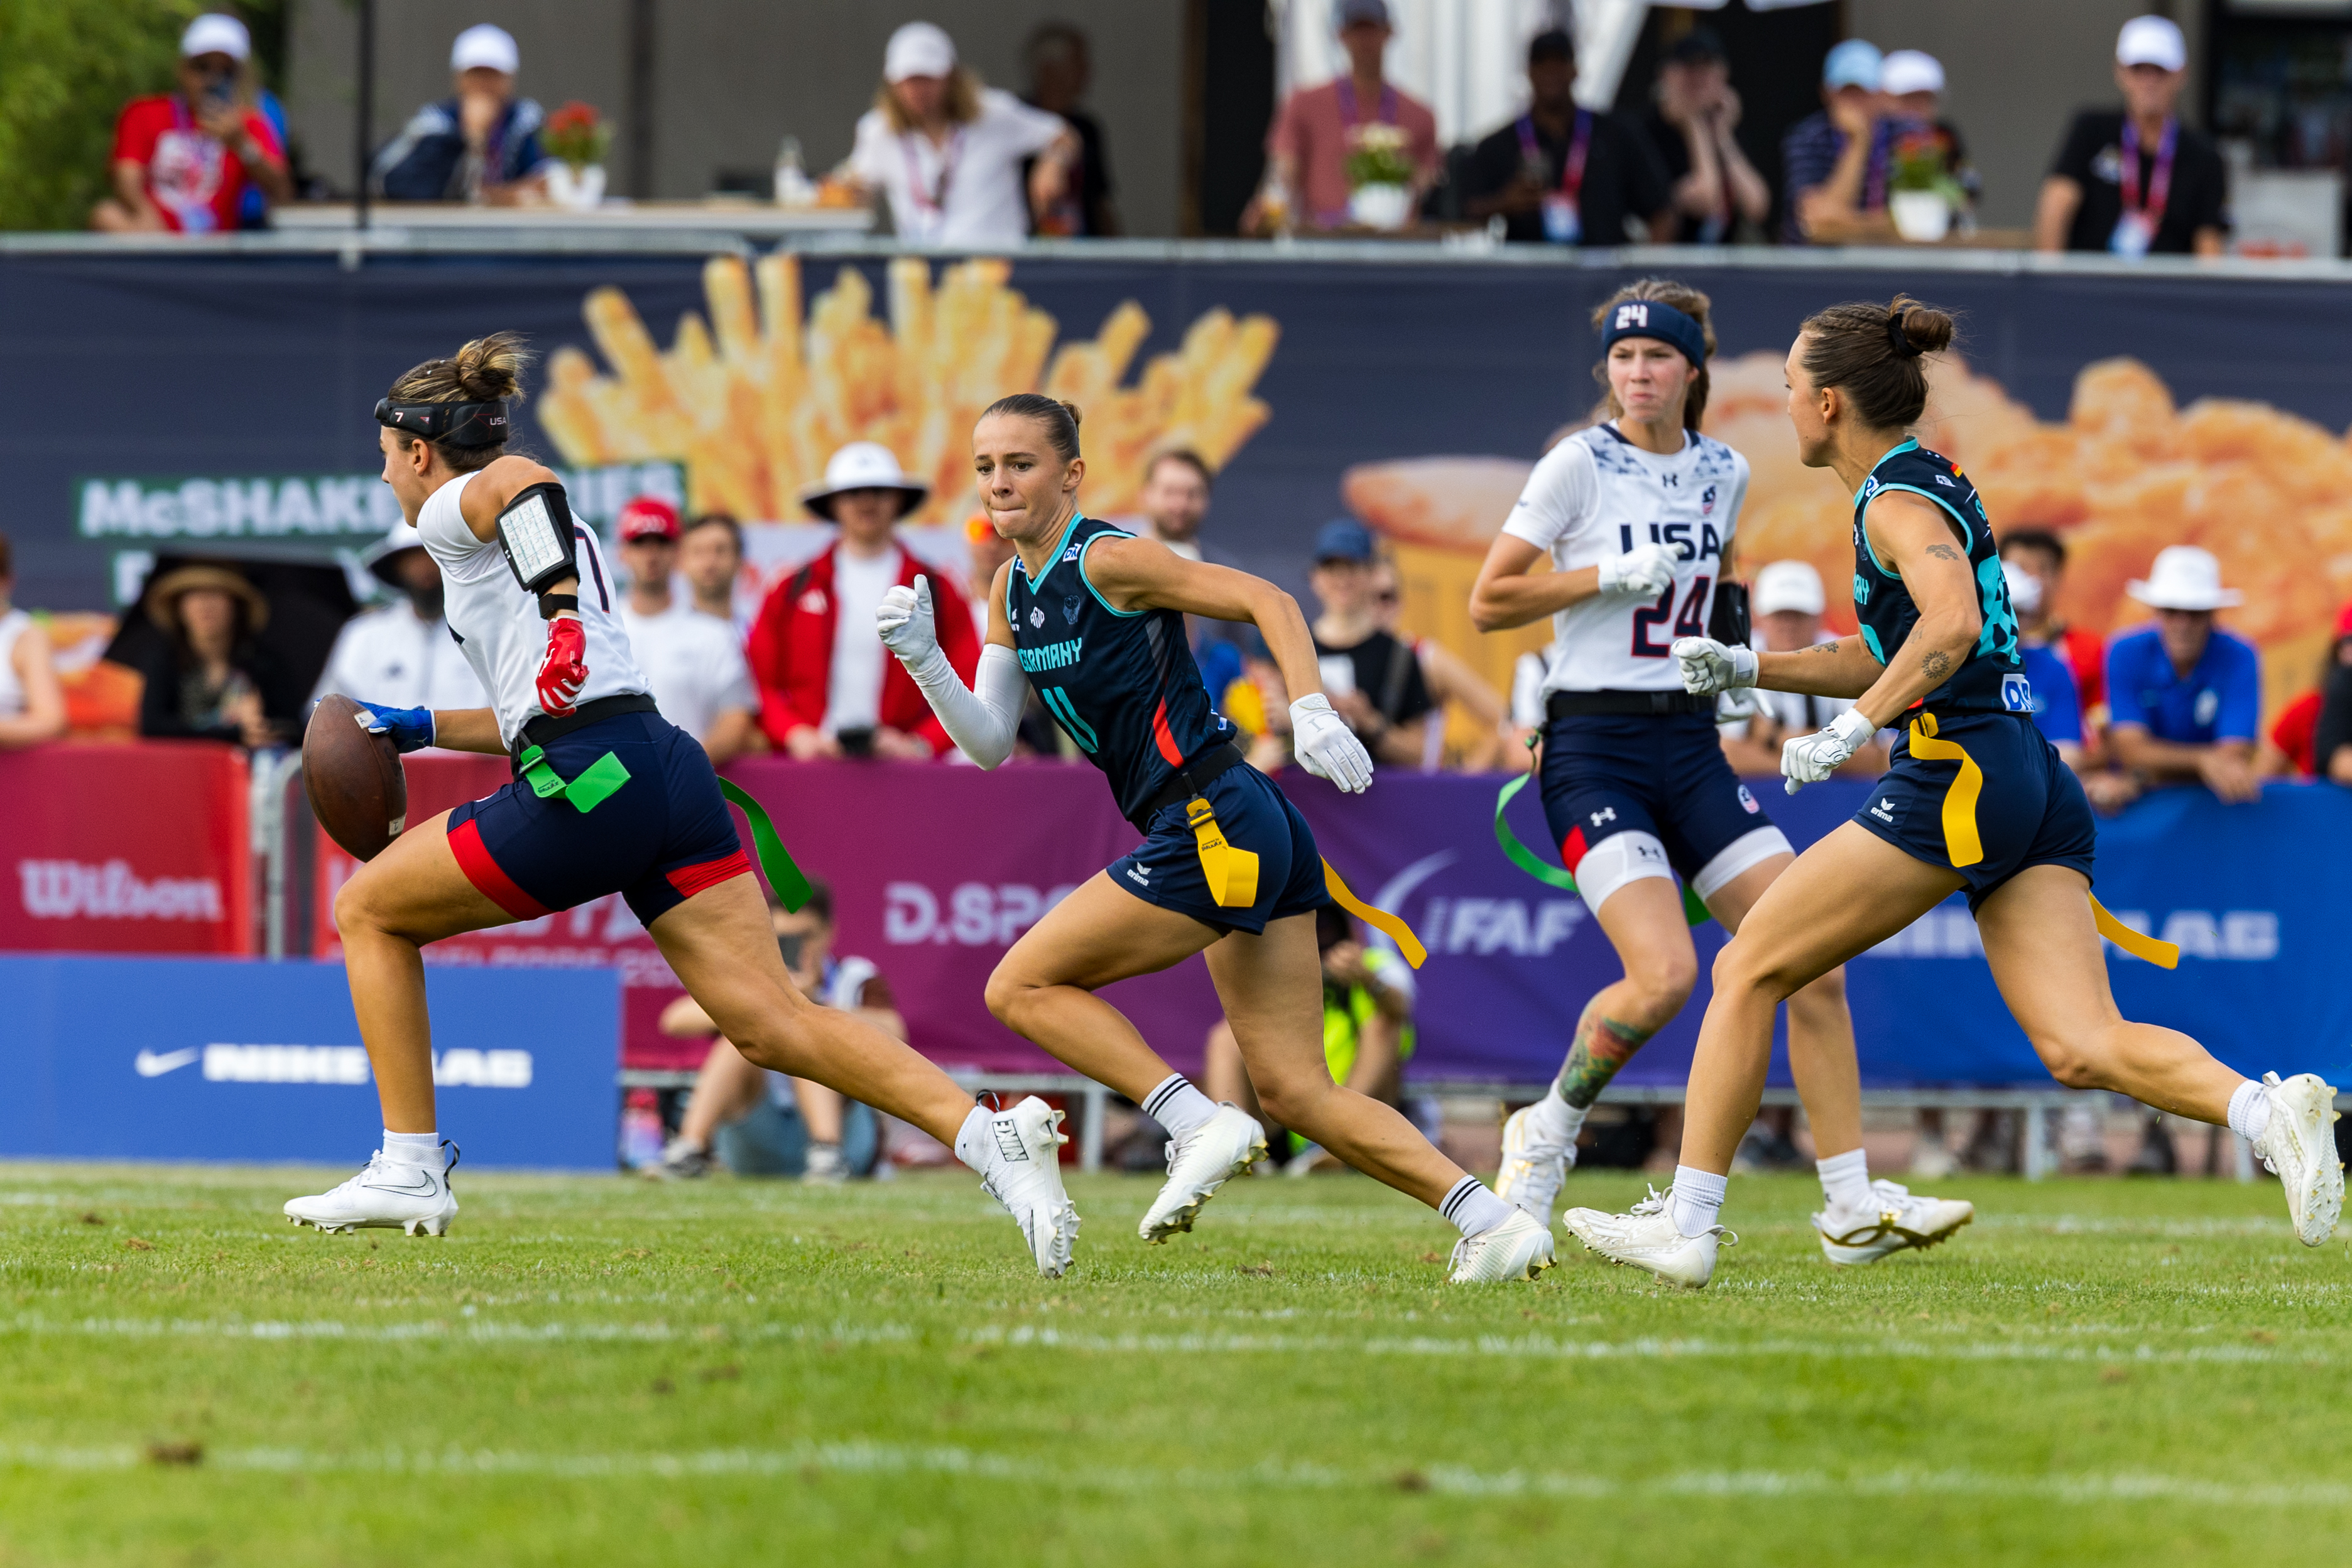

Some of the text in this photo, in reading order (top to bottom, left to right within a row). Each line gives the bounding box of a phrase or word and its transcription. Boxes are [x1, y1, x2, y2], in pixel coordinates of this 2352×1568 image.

[1615, 304, 1648, 329] 24
[395, 411, 403, 422] 7
[489, 417, 507, 425] USA
[80, 476, 408, 538] McSHAKE
[1620, 523, 1721, 561] USA
[1631, 575, 1711, 658] 24
[1017, 636, 1082, 673] GERMANY
[1042, 686, 1099, 754] 11
[1870, 807, 1893, 823] erima
[19, 859, 224, 922] Wilson
[1126, 868, 1150, 887] erima
[203, 1042, 371, 1086] NIKE
